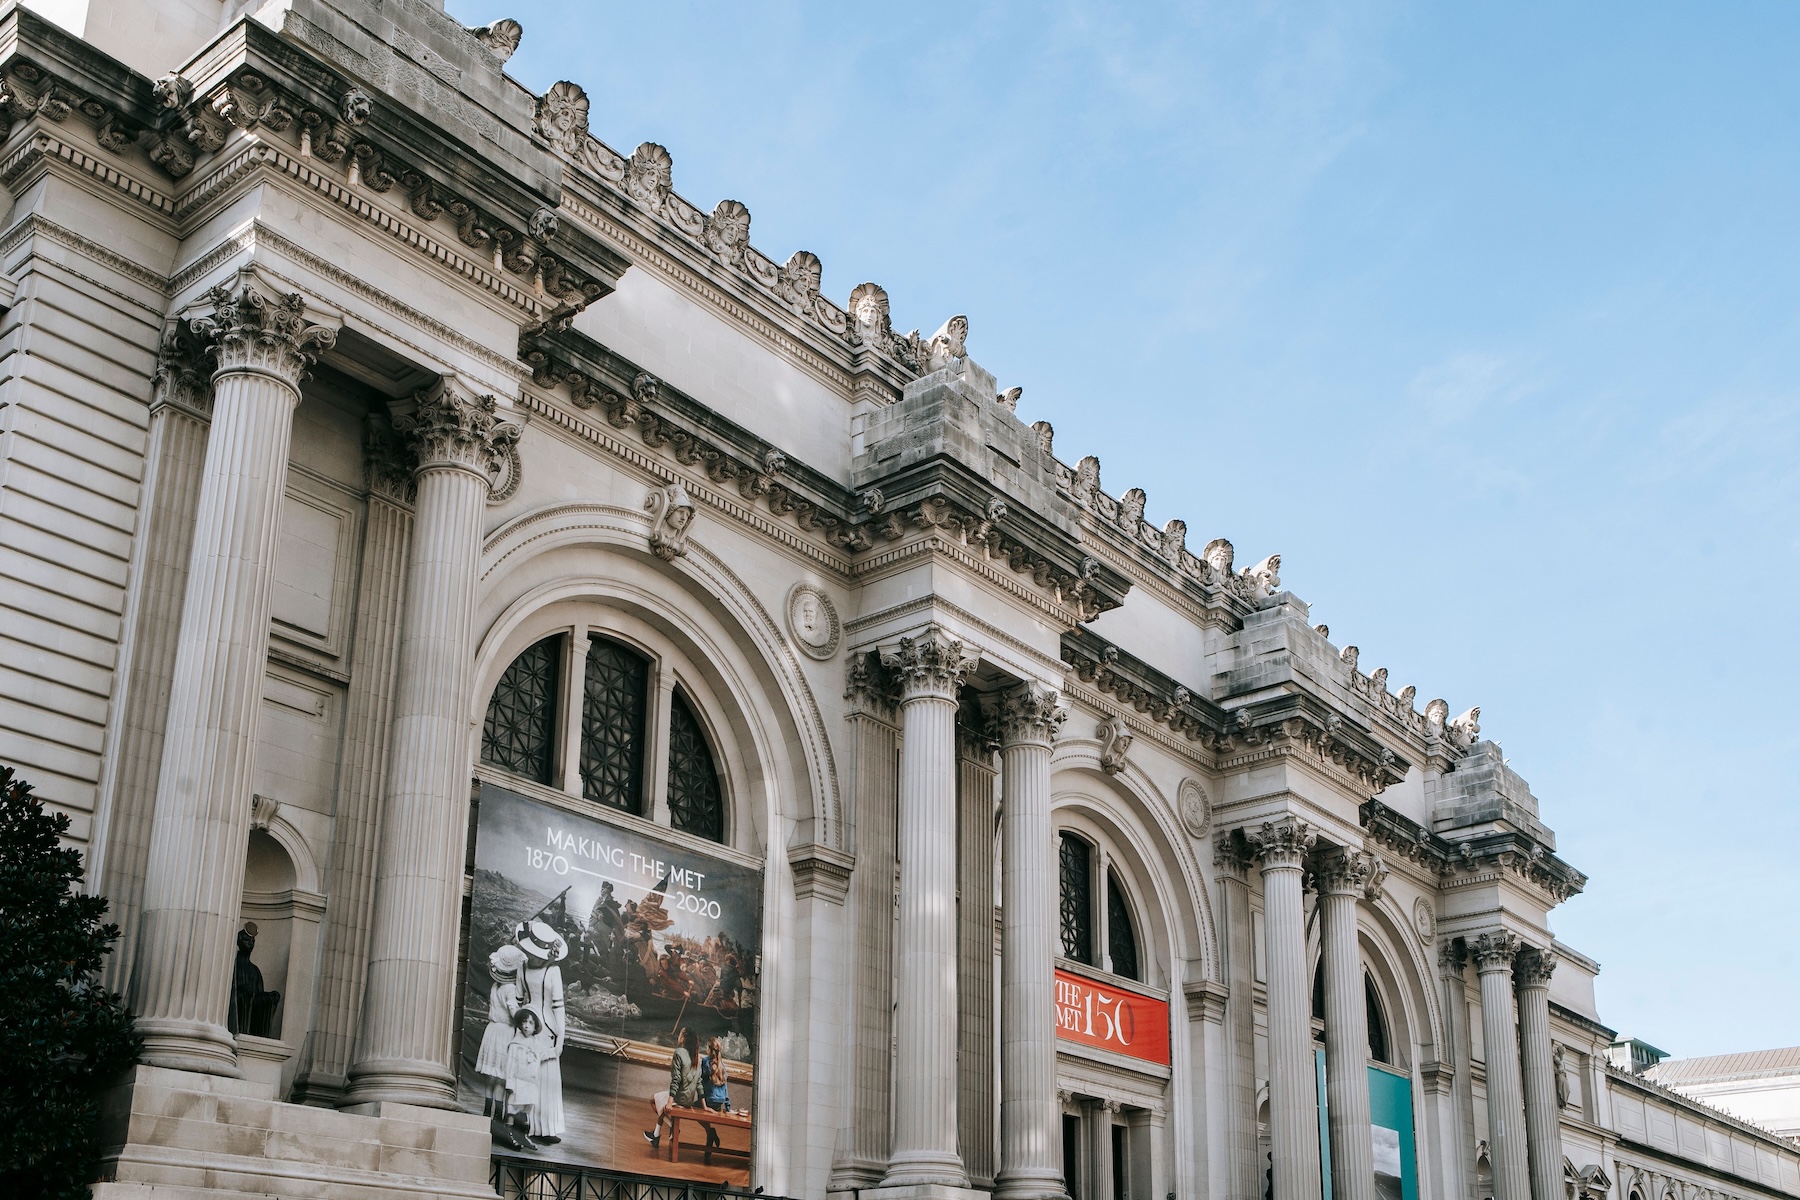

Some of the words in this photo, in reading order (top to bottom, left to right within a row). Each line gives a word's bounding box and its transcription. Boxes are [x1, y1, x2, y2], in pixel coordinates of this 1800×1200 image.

[525, 847, 569, 875] 1870
[676, 891, 721, 919] 2020
[546, 827, 624, 868] MAKING
[630, 853, 665, 881] THE
[670, 865, 705, 891] MET
[1055, 980, 1081, 1008] THE
[1055, 1004, 1082, 1032] MET
[1083, 989, 1135, 1046] 150
